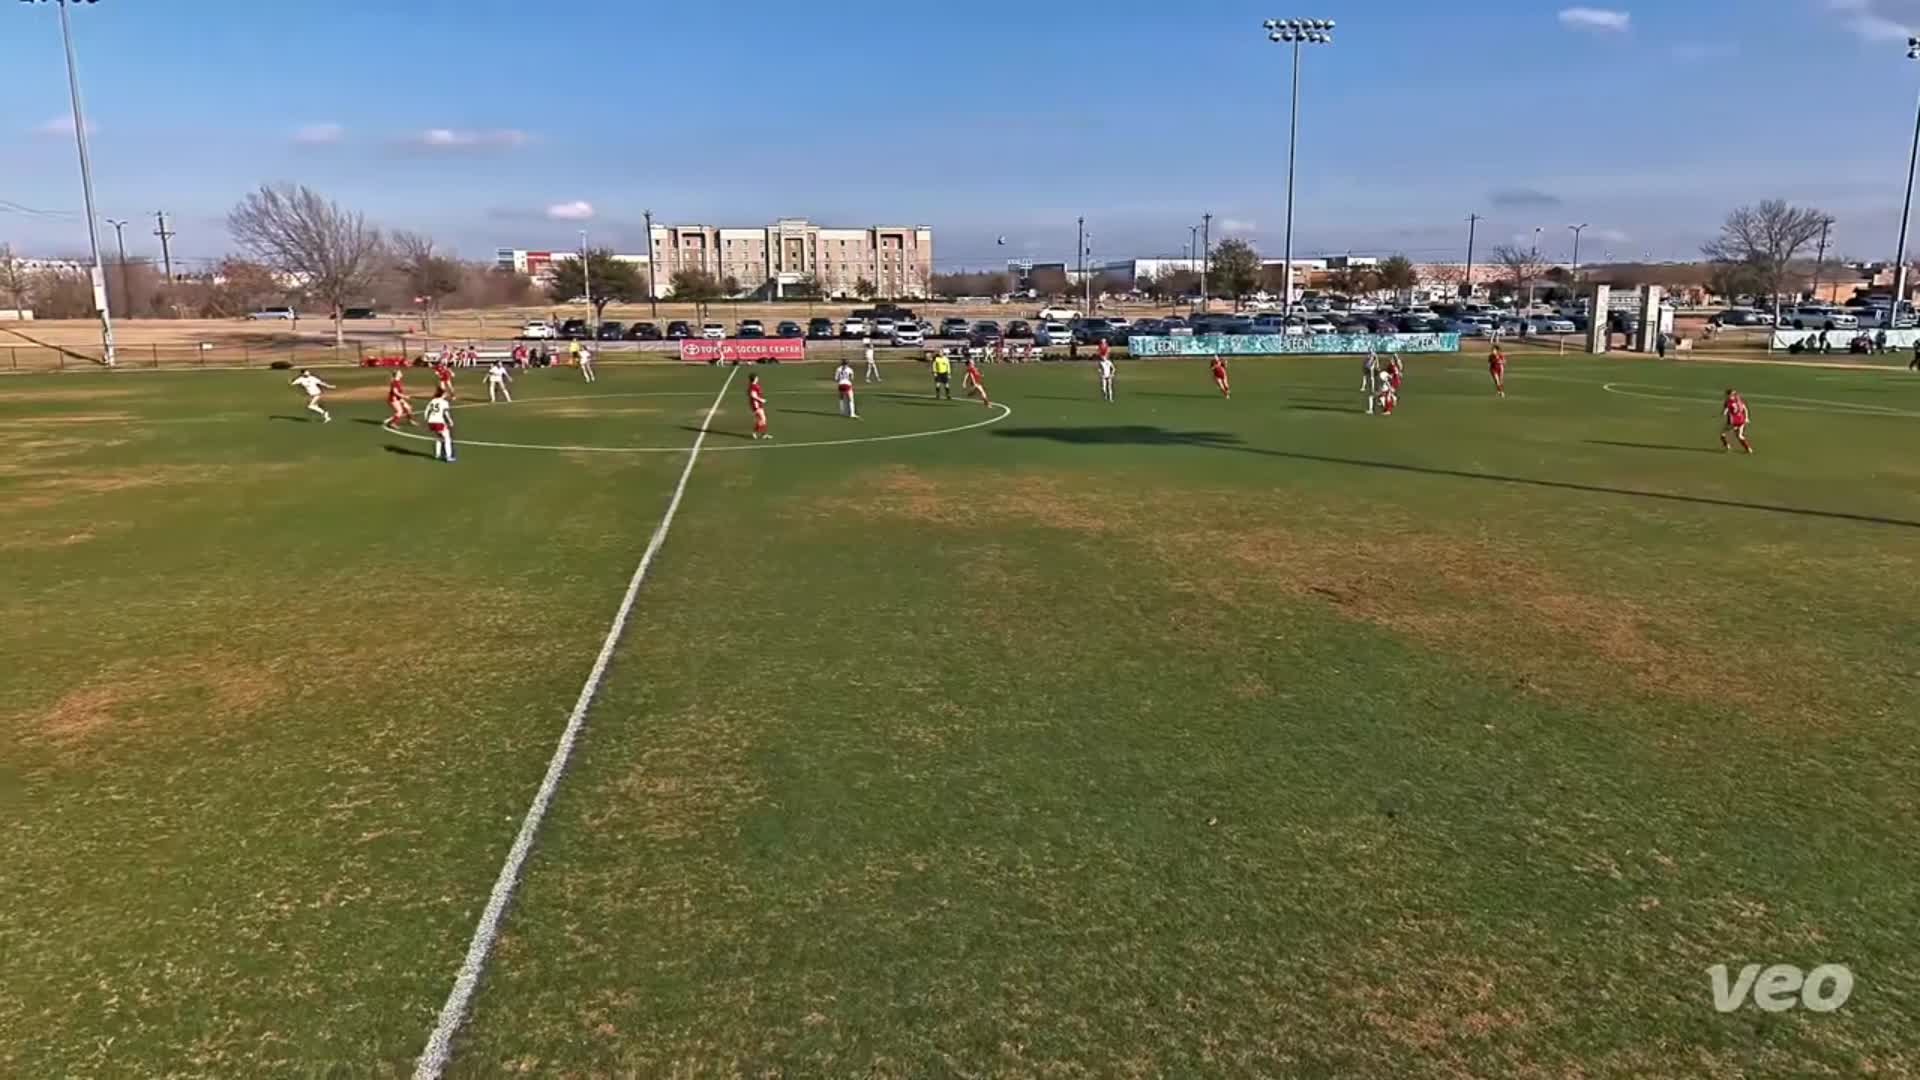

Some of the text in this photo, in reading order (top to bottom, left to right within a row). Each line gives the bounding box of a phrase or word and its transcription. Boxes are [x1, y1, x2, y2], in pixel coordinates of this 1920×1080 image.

[701, 345, 800, 353] TOYTA SOCCER CENTER
